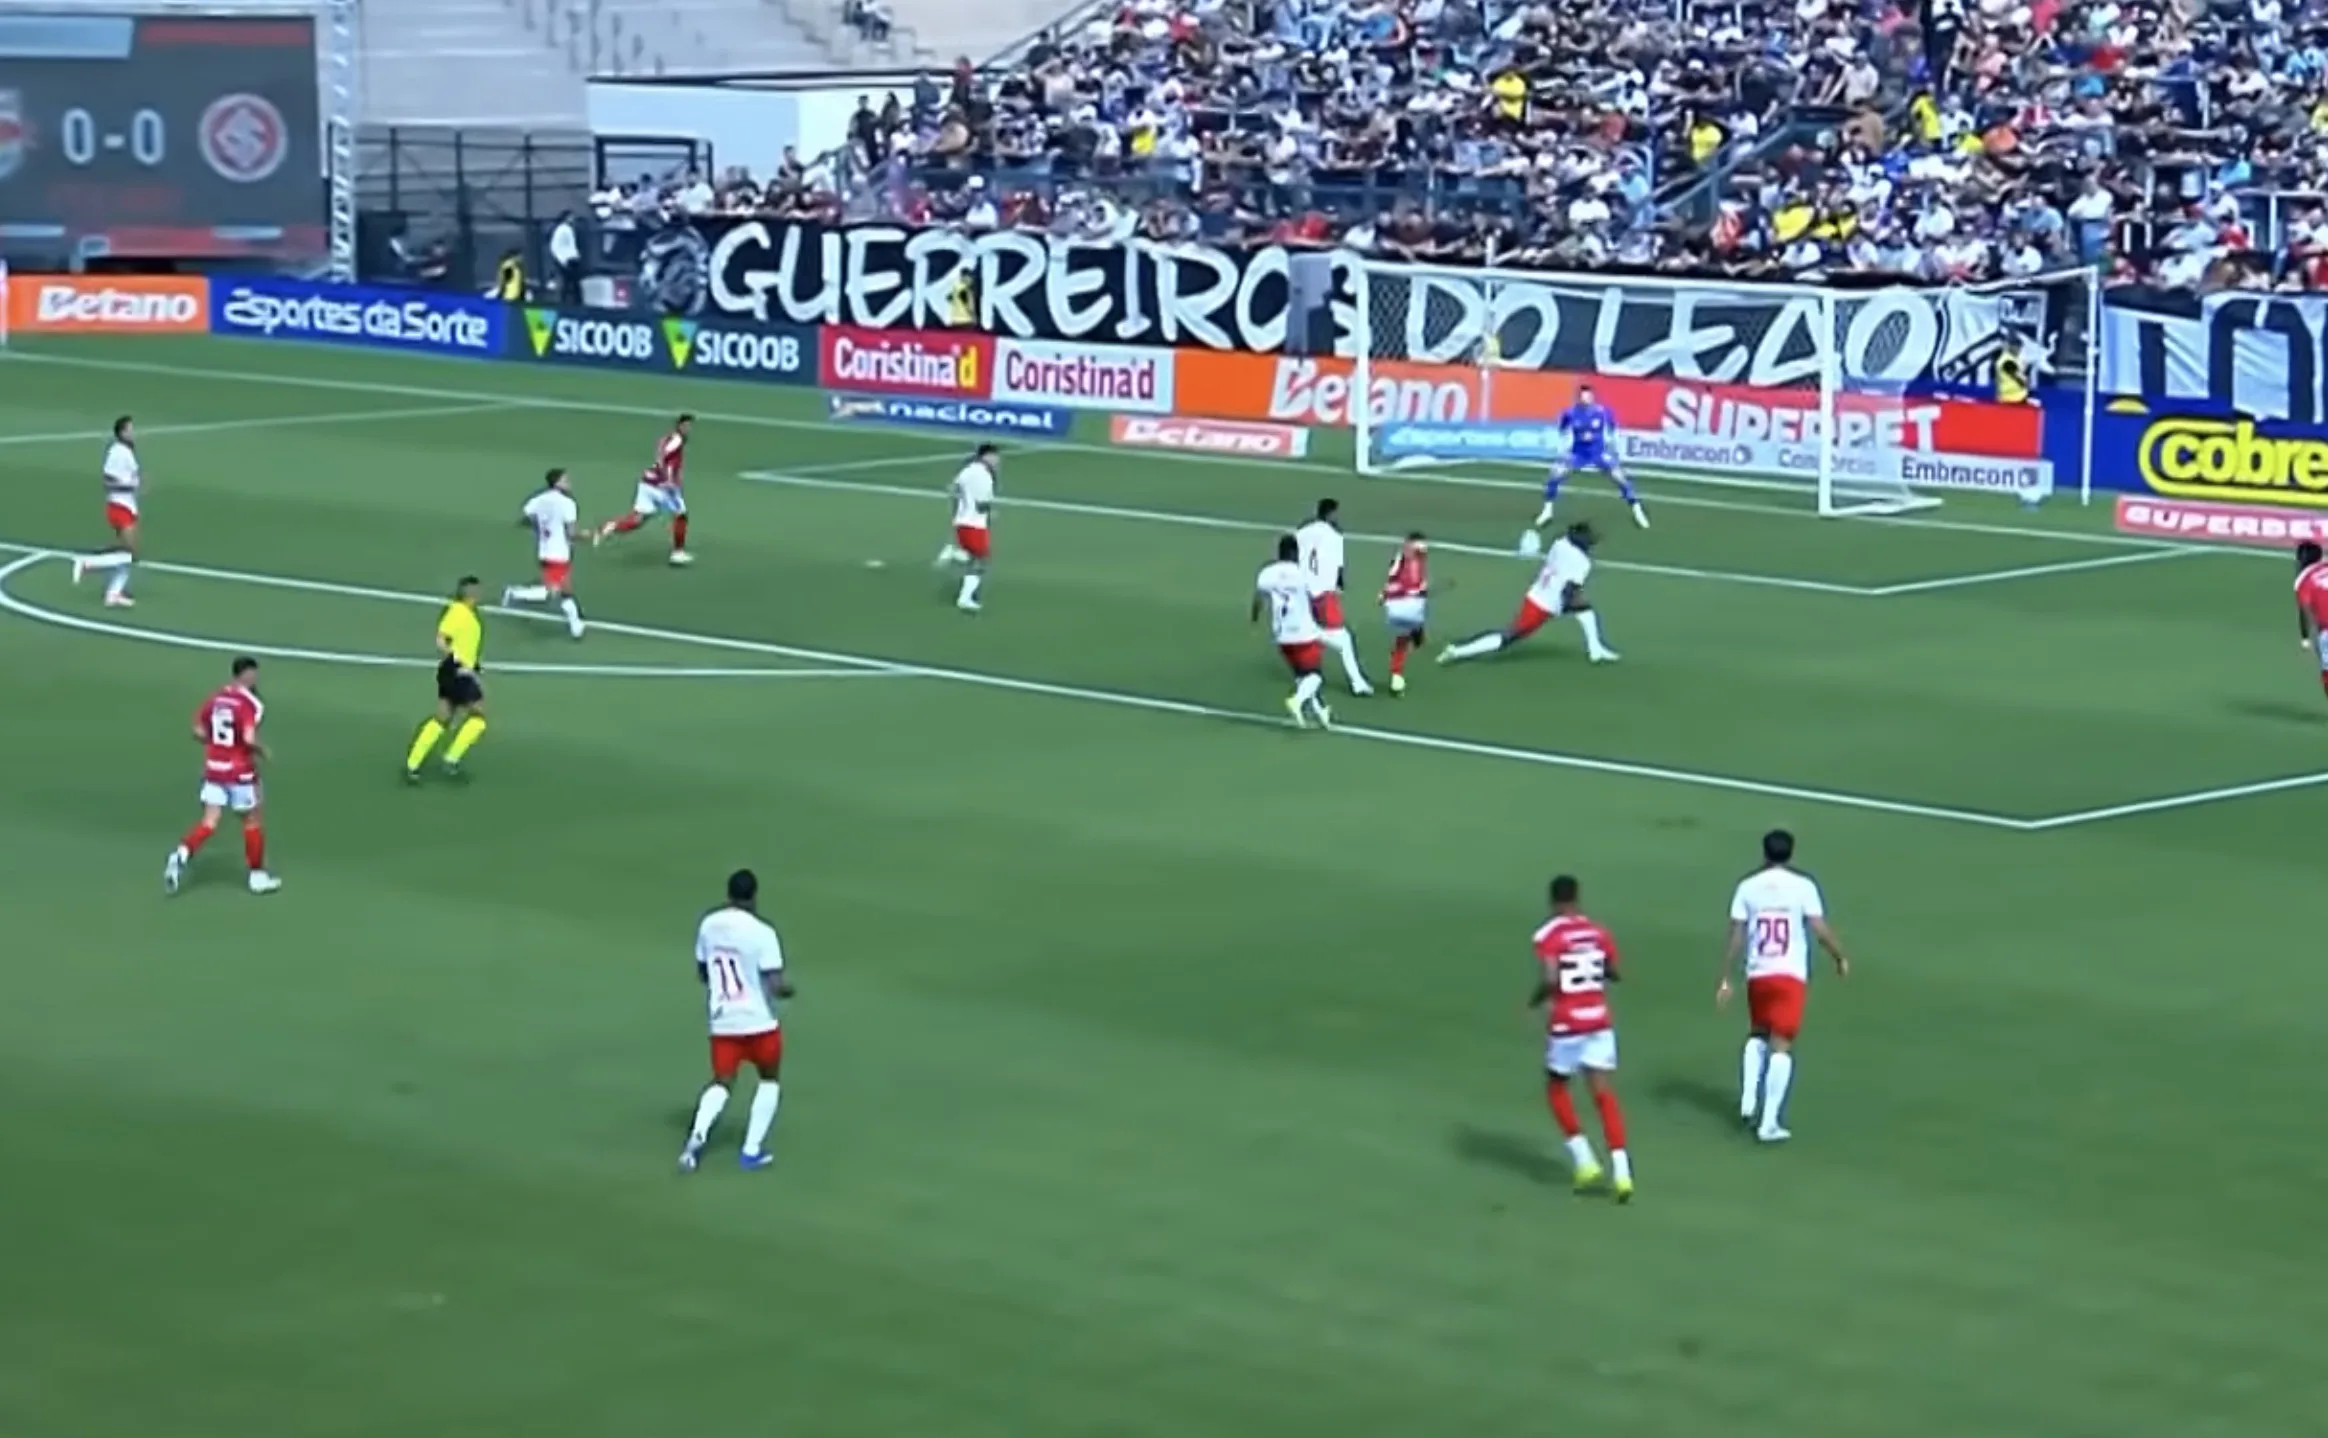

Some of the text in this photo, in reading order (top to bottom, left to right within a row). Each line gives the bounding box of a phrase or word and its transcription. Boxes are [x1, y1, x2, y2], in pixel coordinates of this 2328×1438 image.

[37, 285, 198, 322] Betano
[1406, 273, 1560, 371] DO
[555, 318, 653, 358] SICOOB
[695, 330, 800, 371] SICOOB
[1268, 356, 1469, 424] Betano
[1123, 419, 1281, 453] Betano
[1626, 435, 1730, 464] Embracon
[2160, 421, 2328, 489] cobre
[1901, 457, 2015, 487] Embracon
[1756, 917, 1790, 957] 29
